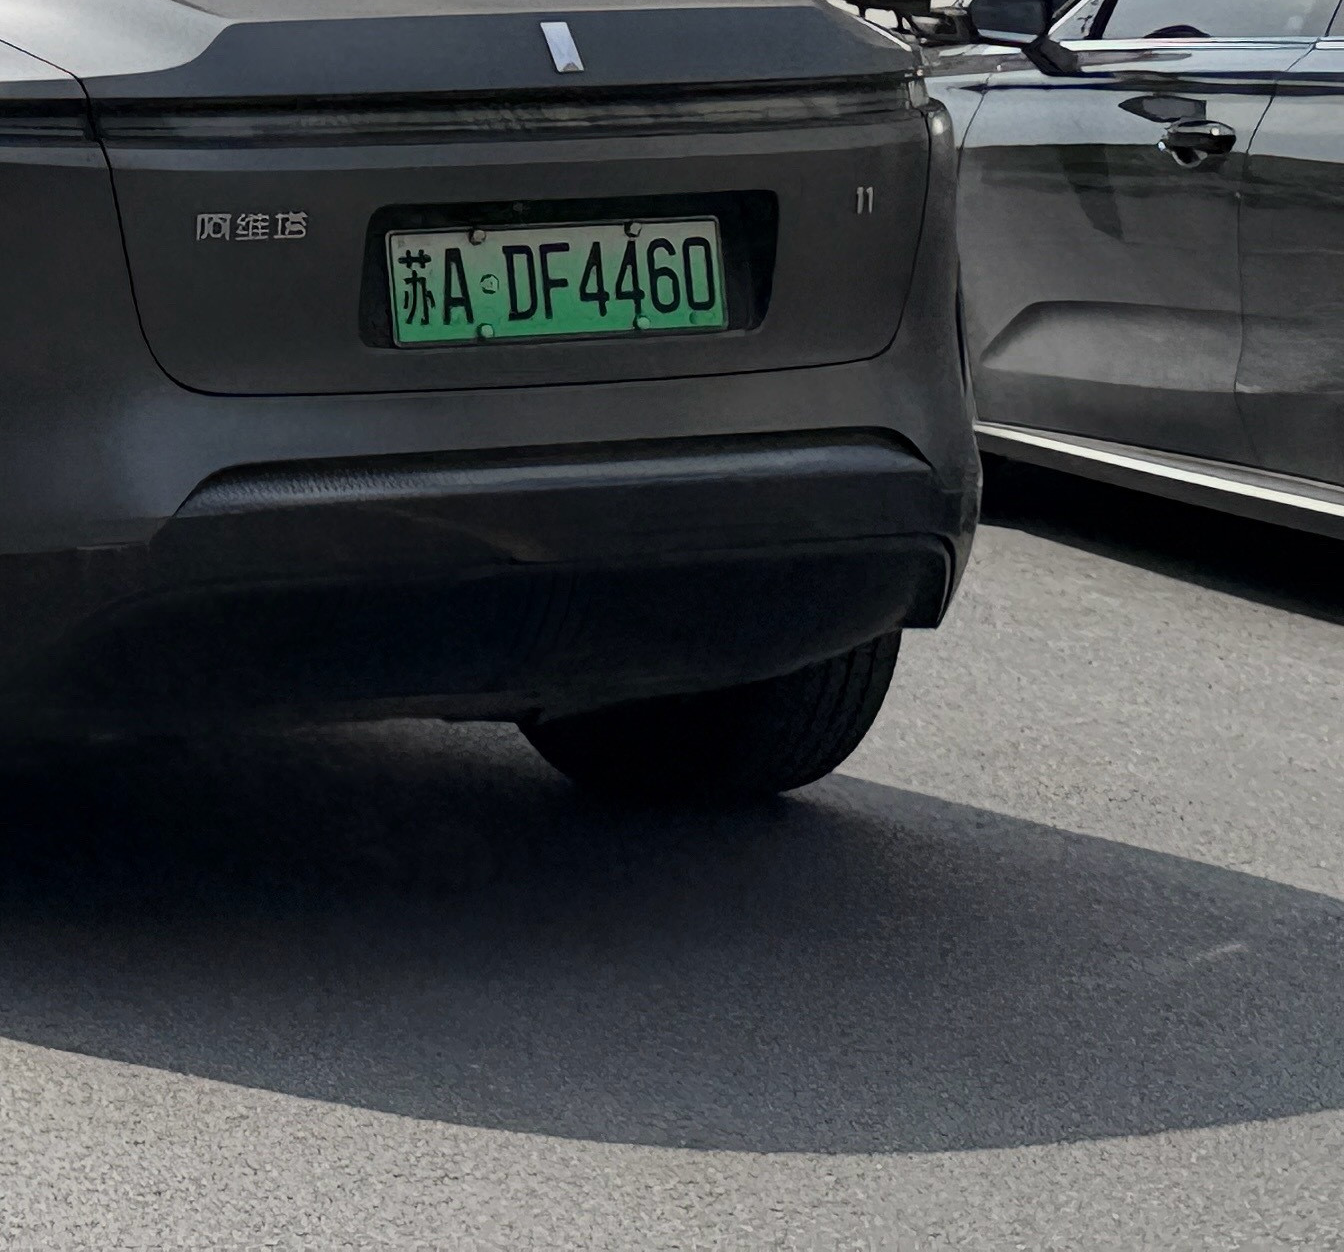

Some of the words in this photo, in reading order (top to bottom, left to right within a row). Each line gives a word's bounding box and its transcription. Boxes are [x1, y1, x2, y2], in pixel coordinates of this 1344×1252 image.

[856, 186, 874, 215] 11
[196, 211, 309, 241] 阿维塔
[502, 235, 717, 322] DF4460
